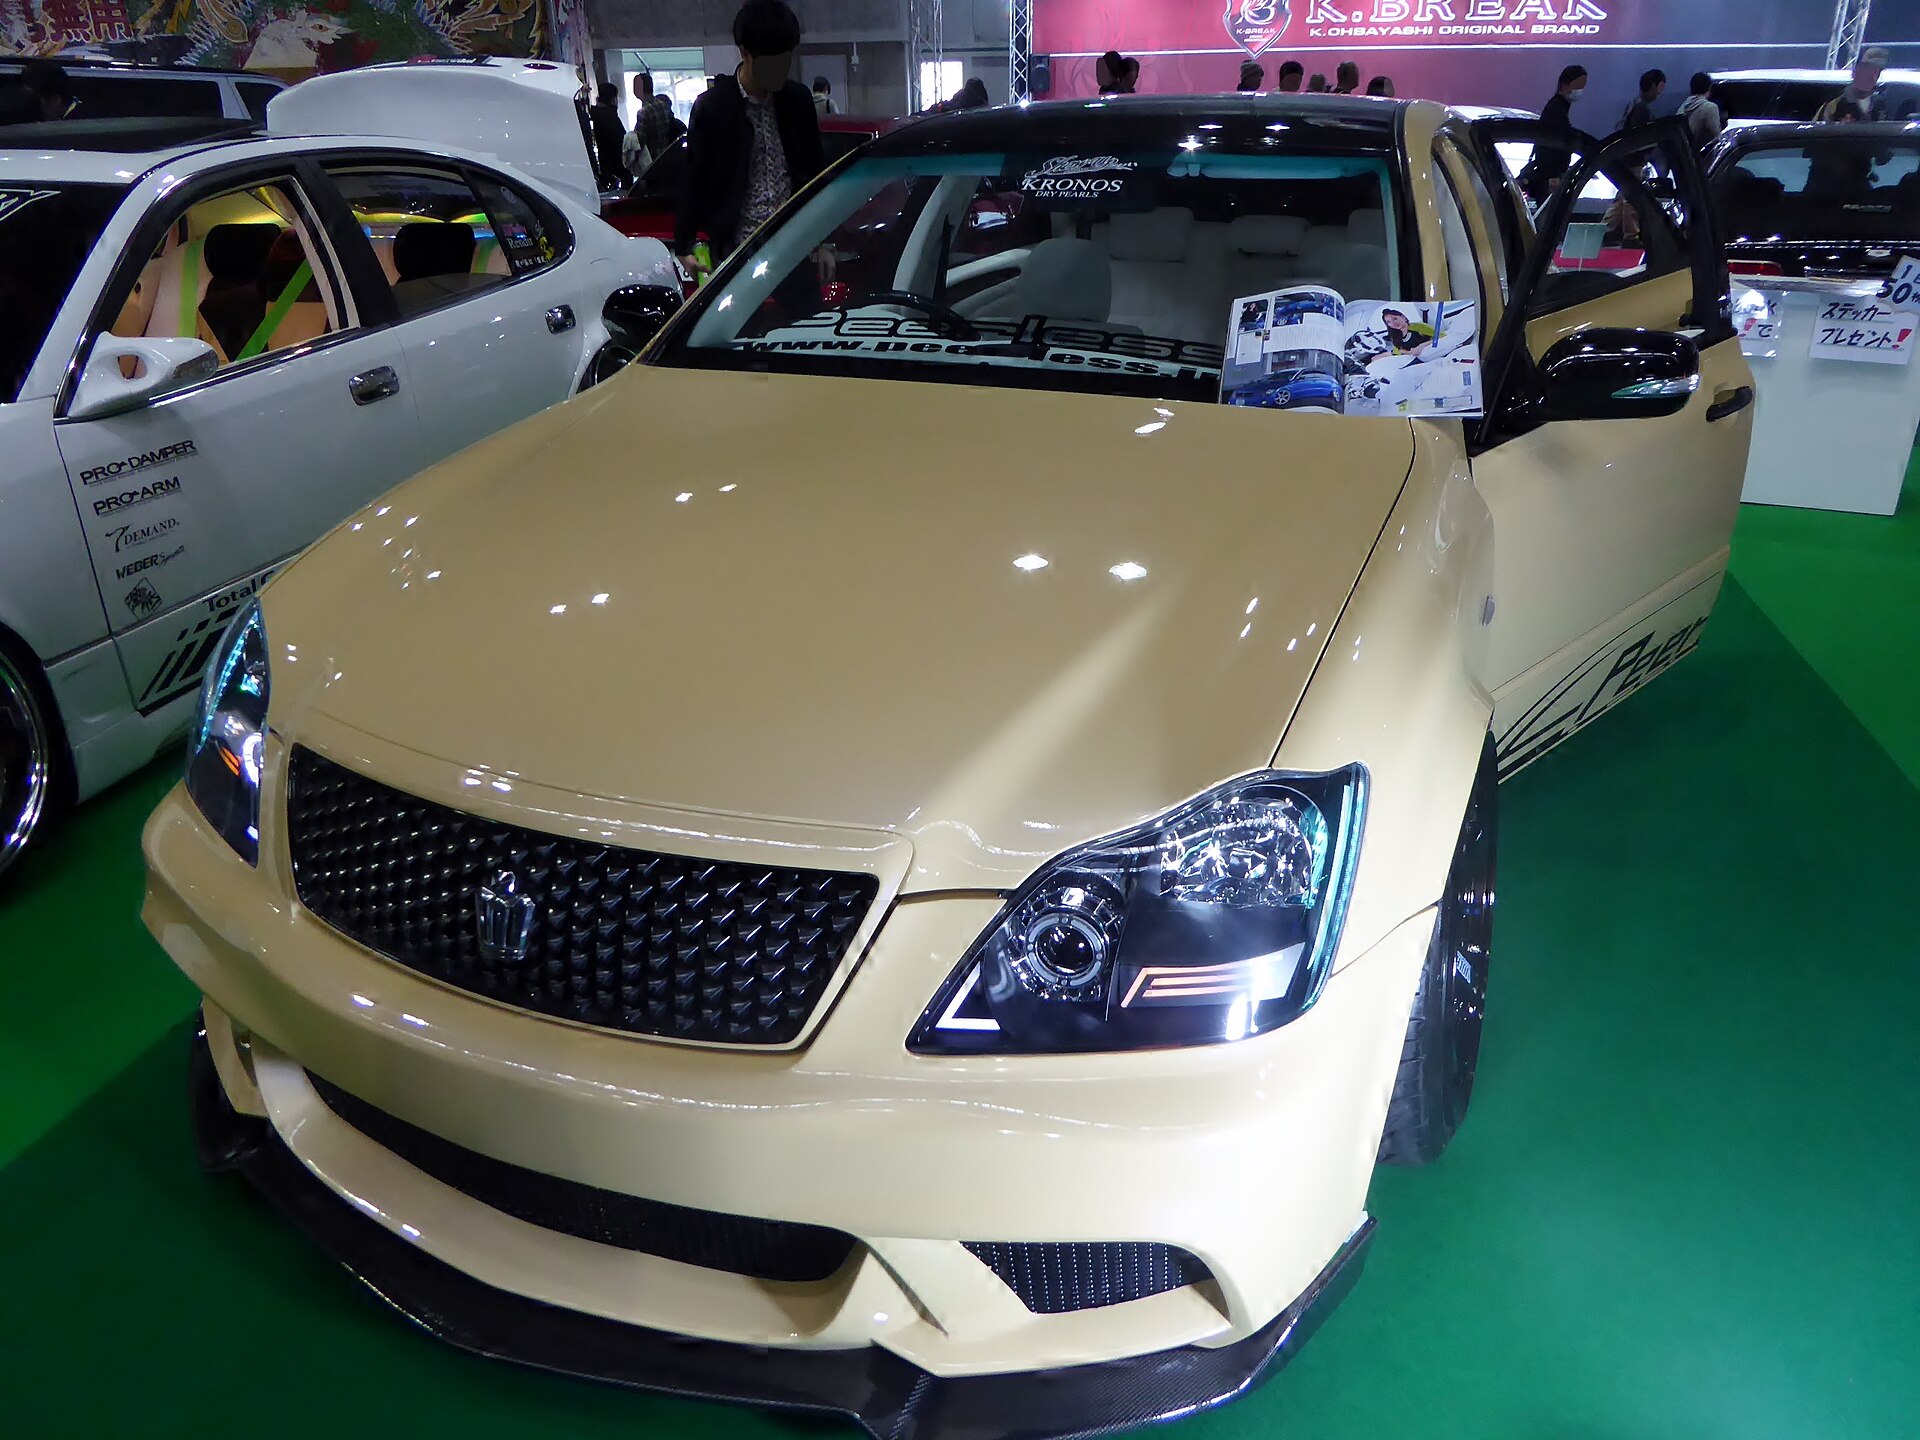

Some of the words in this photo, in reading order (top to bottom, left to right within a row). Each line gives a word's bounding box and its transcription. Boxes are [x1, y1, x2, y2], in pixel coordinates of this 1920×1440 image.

[1309, 26, 1433, 36] K.OHBAYASHI
[1438, 25, 1526, 35] ORIGINAL
[1531, 24, 1600, 34] BRAND
[1021, 179, 1123, 192] KRONOS
[1821, 302, 1892, 321] ステッカー
[115, 554, 159, 580] WEBER
[202, 578, 257, 612] Total
